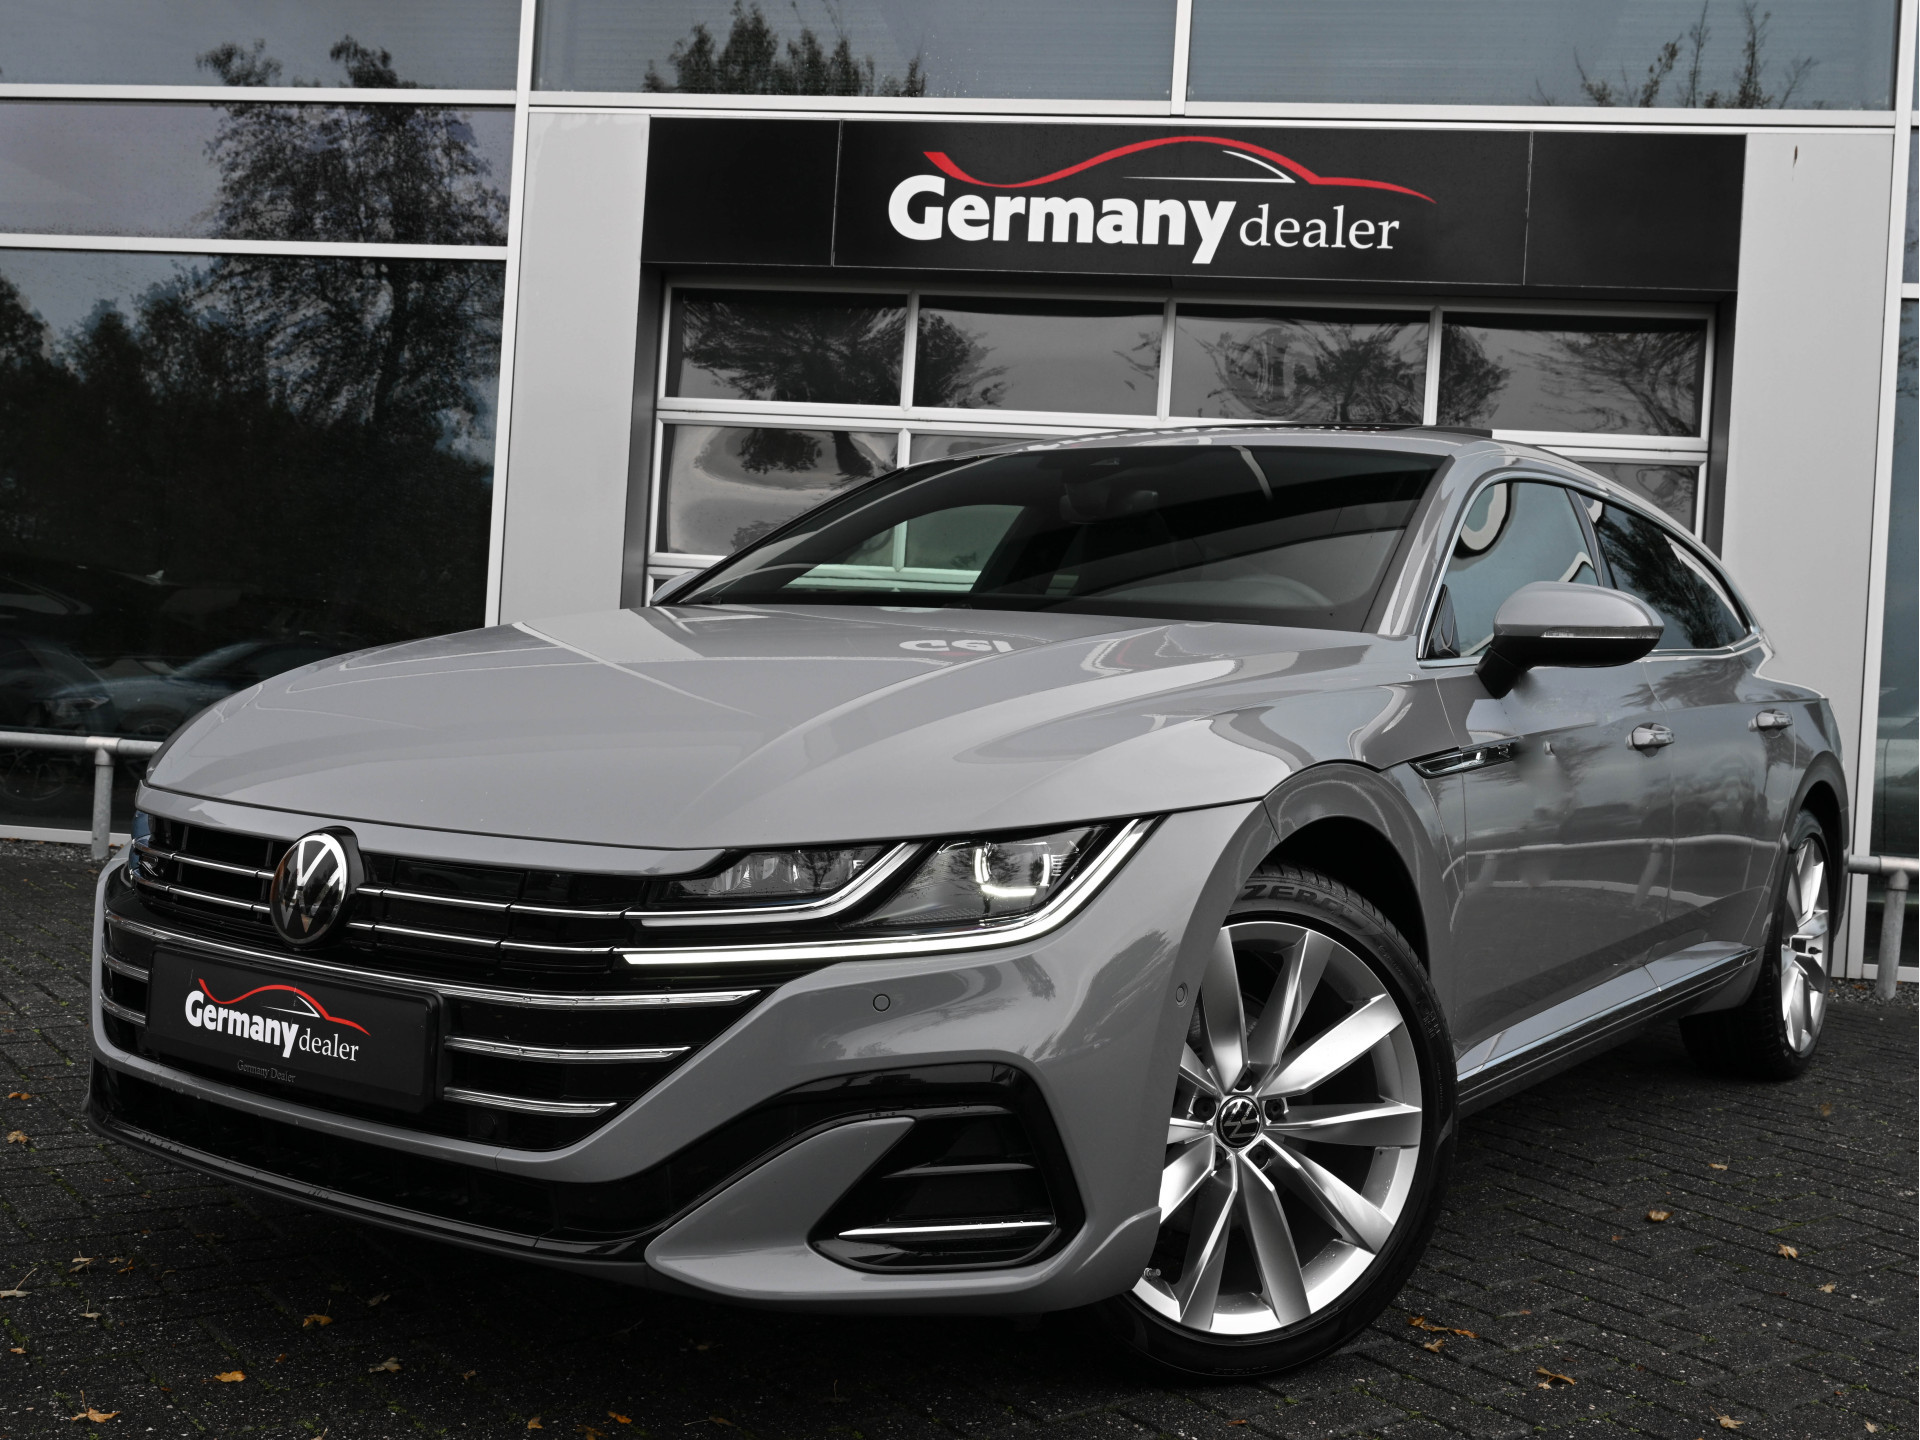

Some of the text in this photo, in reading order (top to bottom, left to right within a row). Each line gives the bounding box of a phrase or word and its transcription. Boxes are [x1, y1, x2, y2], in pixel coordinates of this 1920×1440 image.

[889, 175, 1400, 264] Germany dealer
[185, 990, 360, 1062] Germany dealer
[236, 1059, 297, 1084] Germany Dealer
